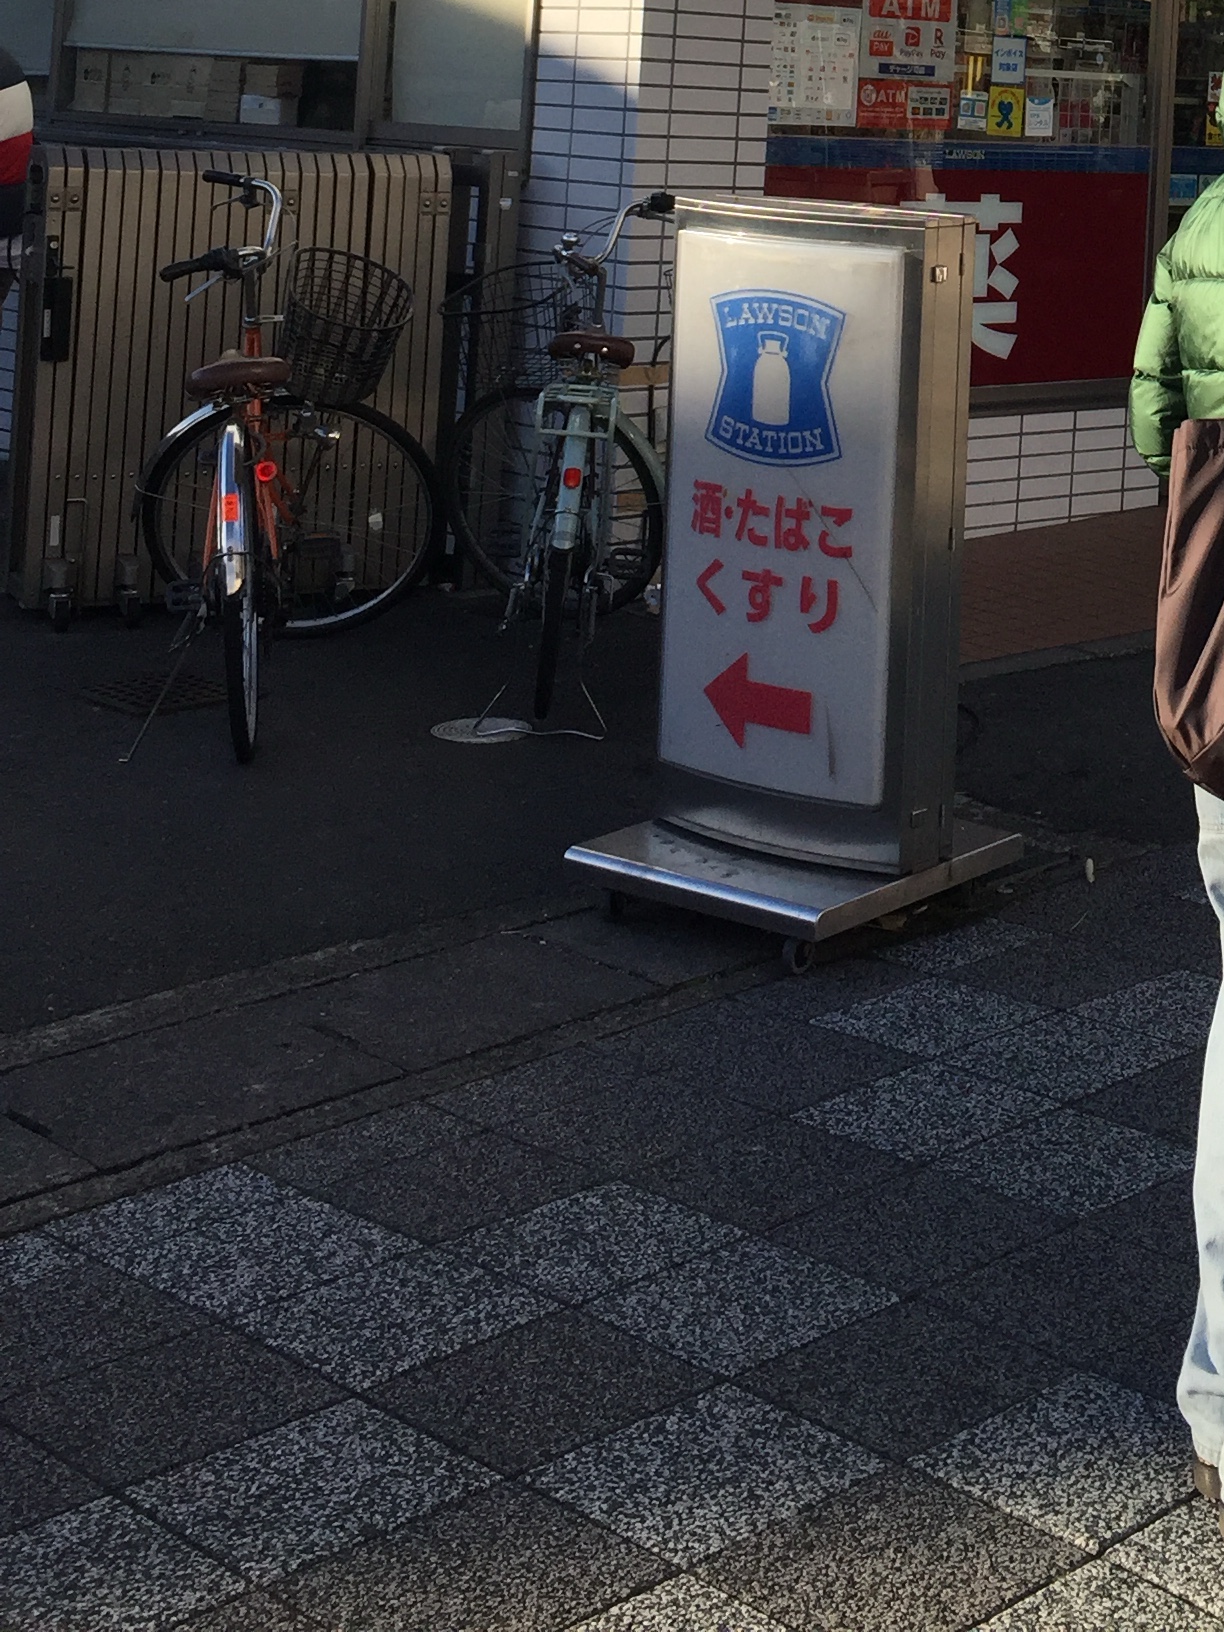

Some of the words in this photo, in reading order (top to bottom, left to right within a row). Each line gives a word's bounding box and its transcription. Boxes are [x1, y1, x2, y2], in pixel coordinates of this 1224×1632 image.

[873, 42, 890, 52] PAY
[930, 49, 947, 60] Pay
[877, 89, 906, 103] ATM
[945, 149, 986, 160] LAWSON
[723, 301, 831, 340] LAWSON
[719, 415, 823, 454] STATION
[695, 558, 840, 633] くすり
